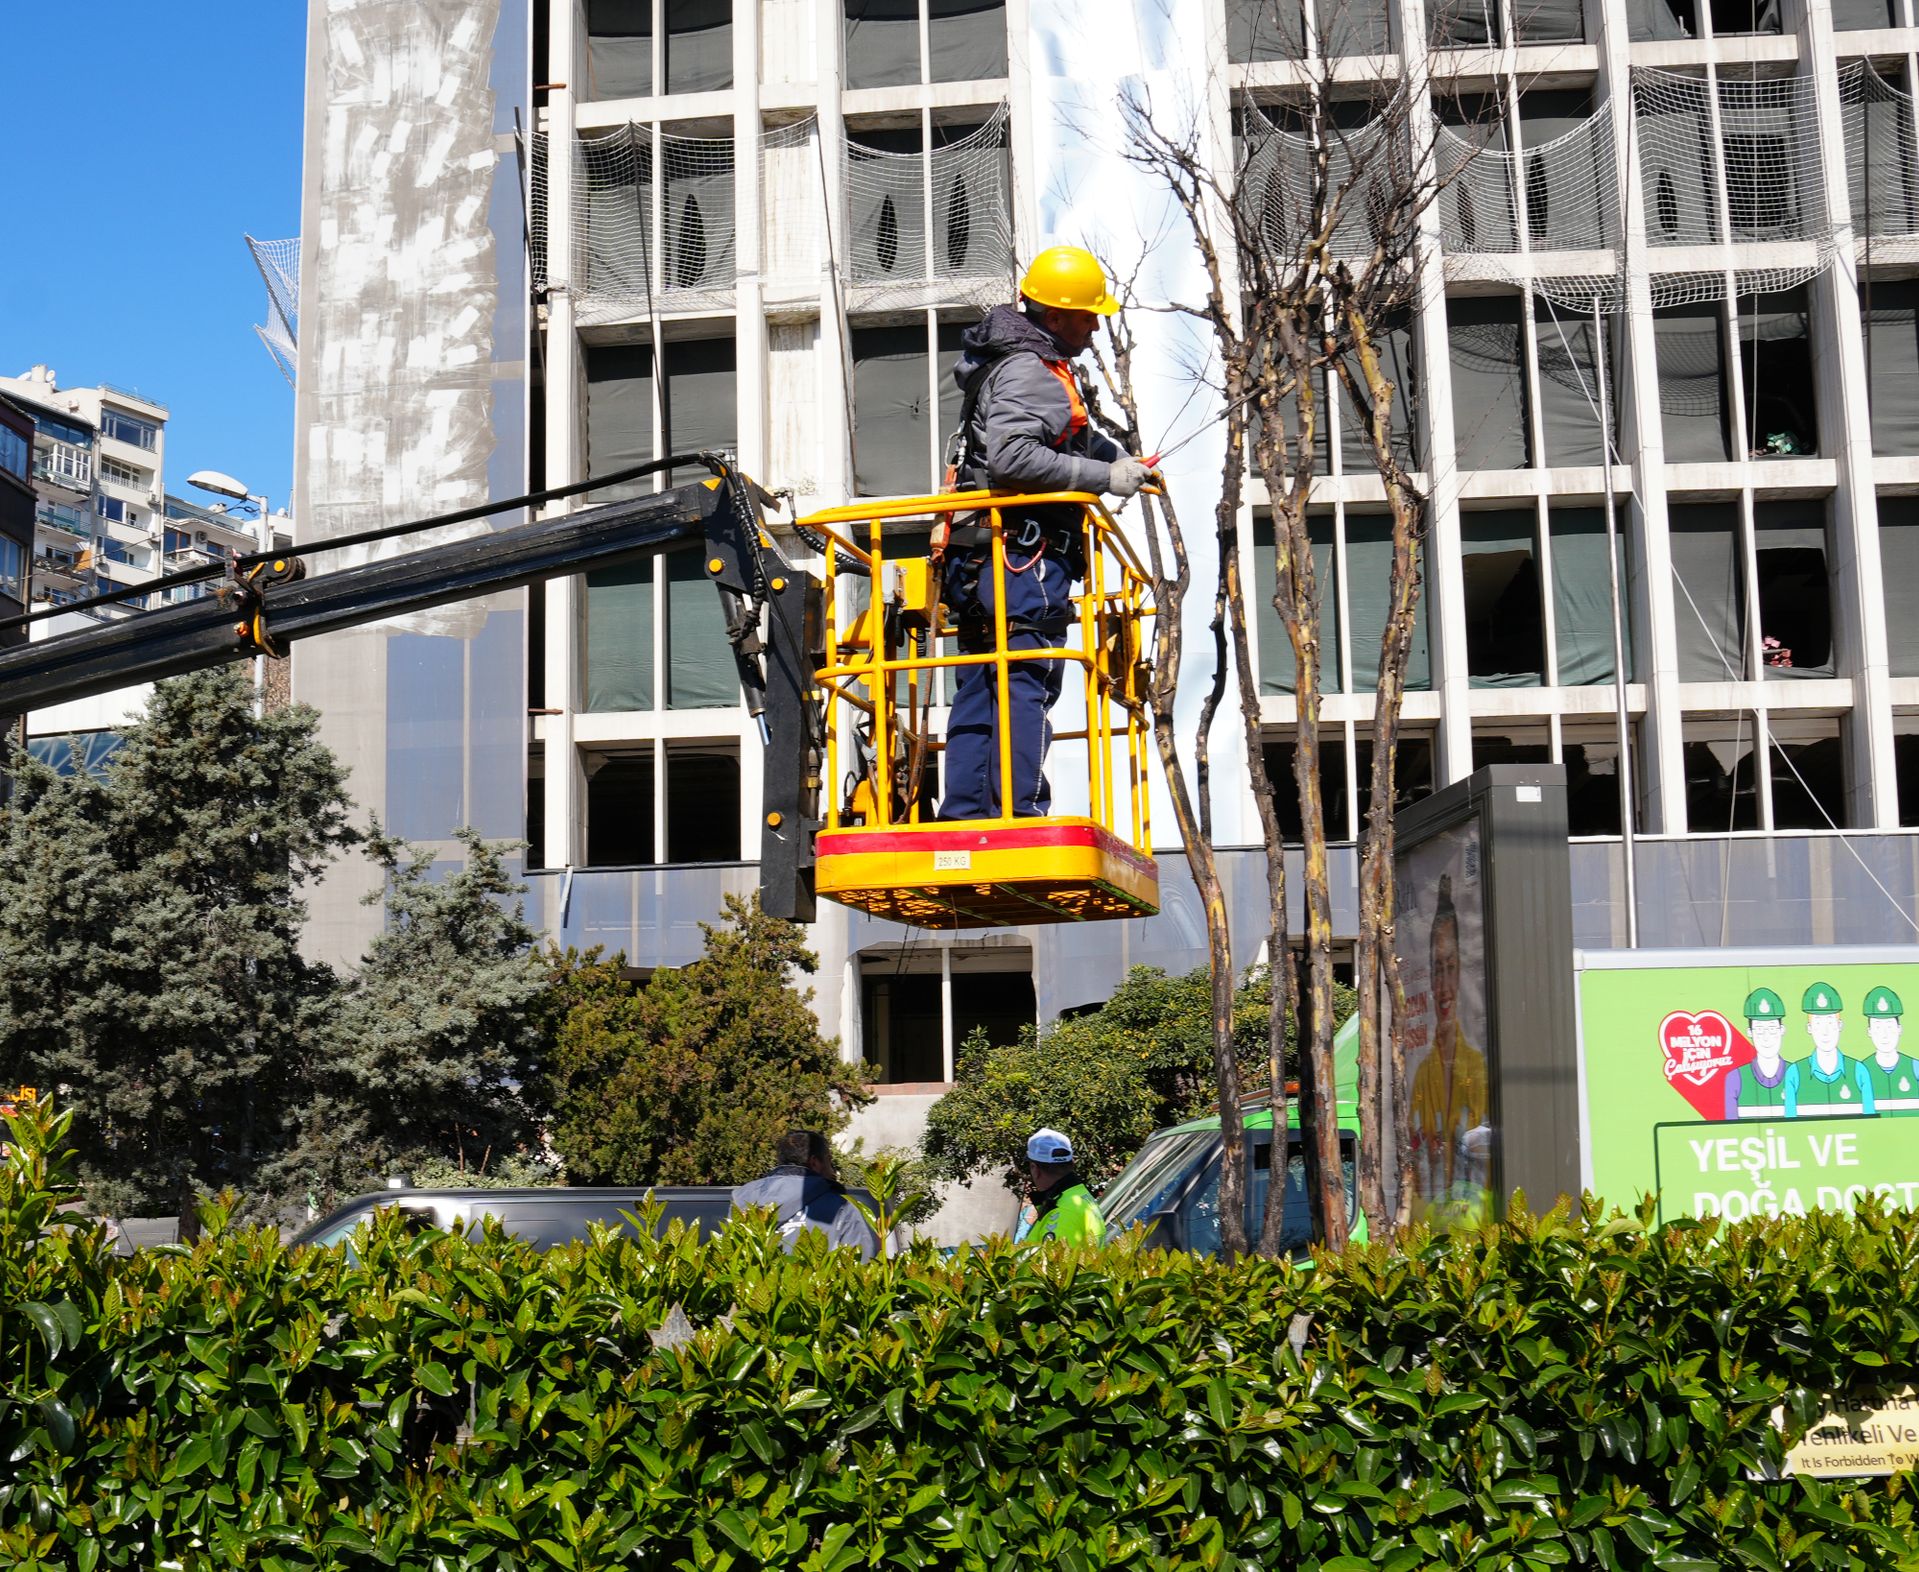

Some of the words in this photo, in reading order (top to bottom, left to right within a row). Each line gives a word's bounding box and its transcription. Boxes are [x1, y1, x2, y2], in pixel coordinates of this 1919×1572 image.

[938, 856, 952, 867] 250
[954, 856, 967, 866] KG
[1687, 1024, 1703, 1036] 16
[1689, 1128, 1801, 1182] YEŞİL
[1807, 1133, 1860, 1167] VE
[1693, 1180, 1808, 1225] DOĞA
[1887, 1425, 1918, 1443] Ve
[1802, 1458, 1811, 1469] It
[1813, 1458, 1823, 1468] Is
[1825, 1455, 1886, 1468] Forbidden
[1887, 1453, 1904, 1465] To
